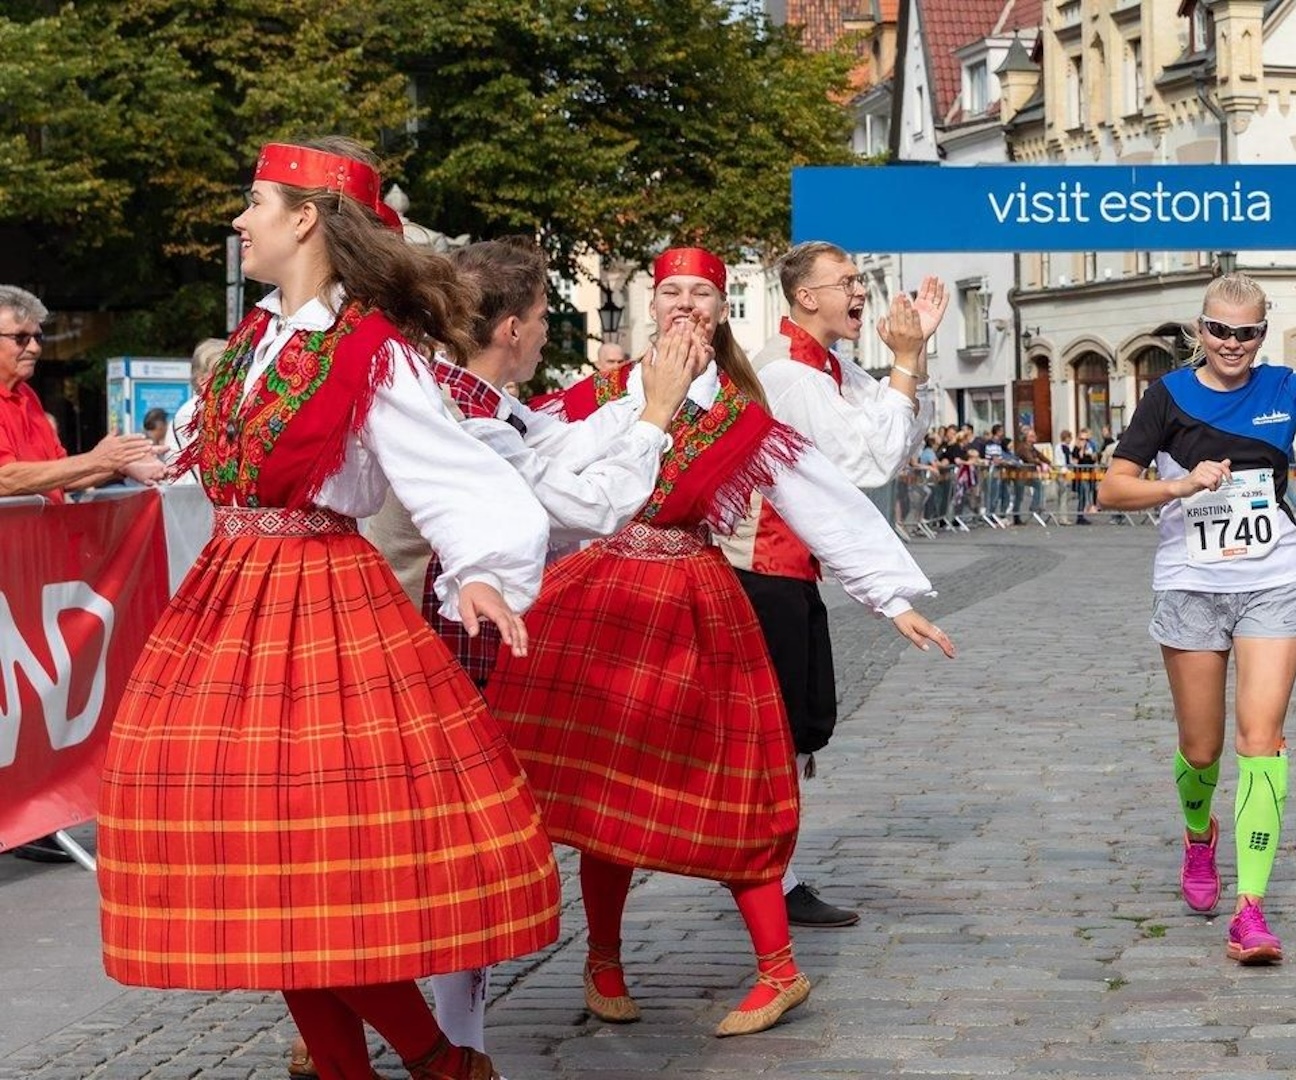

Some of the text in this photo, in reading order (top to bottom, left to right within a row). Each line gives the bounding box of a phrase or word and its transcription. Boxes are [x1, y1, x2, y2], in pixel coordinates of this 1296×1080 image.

[988, 180, 1271, 224] visit estonia
[1186, 504, 1234, 518] KRISTIINA
[1193, 513, 1272, 550] 1740
